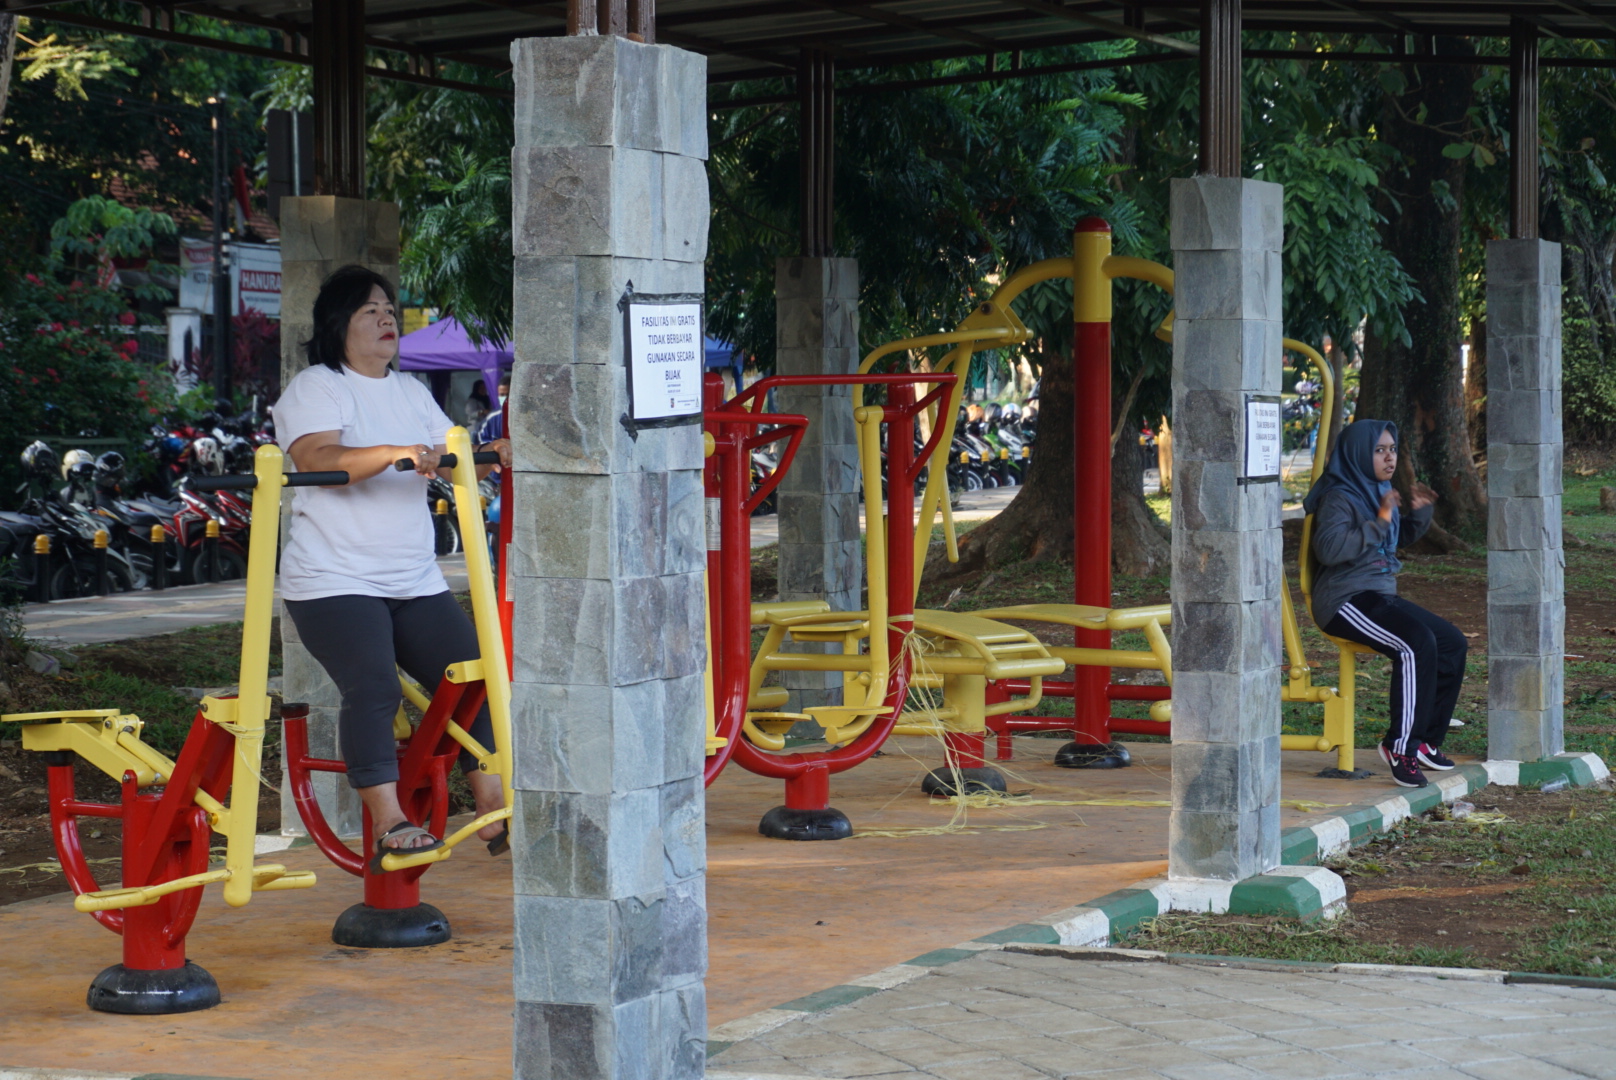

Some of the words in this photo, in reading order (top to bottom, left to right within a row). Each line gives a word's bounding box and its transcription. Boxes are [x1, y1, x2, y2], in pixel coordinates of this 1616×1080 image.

[242, 271, 281, 291] HANURA
[641, 316, 669, 327] FASILITAS
[678, 315, 696, 326] GRATIS
[648, 334, 666, 345] TIDAK
[666, 333, 692, 344] BERBAYAR
[646, 352, 676, 364] GUNAKAN
[676, 351, 695, 362] SECARA
